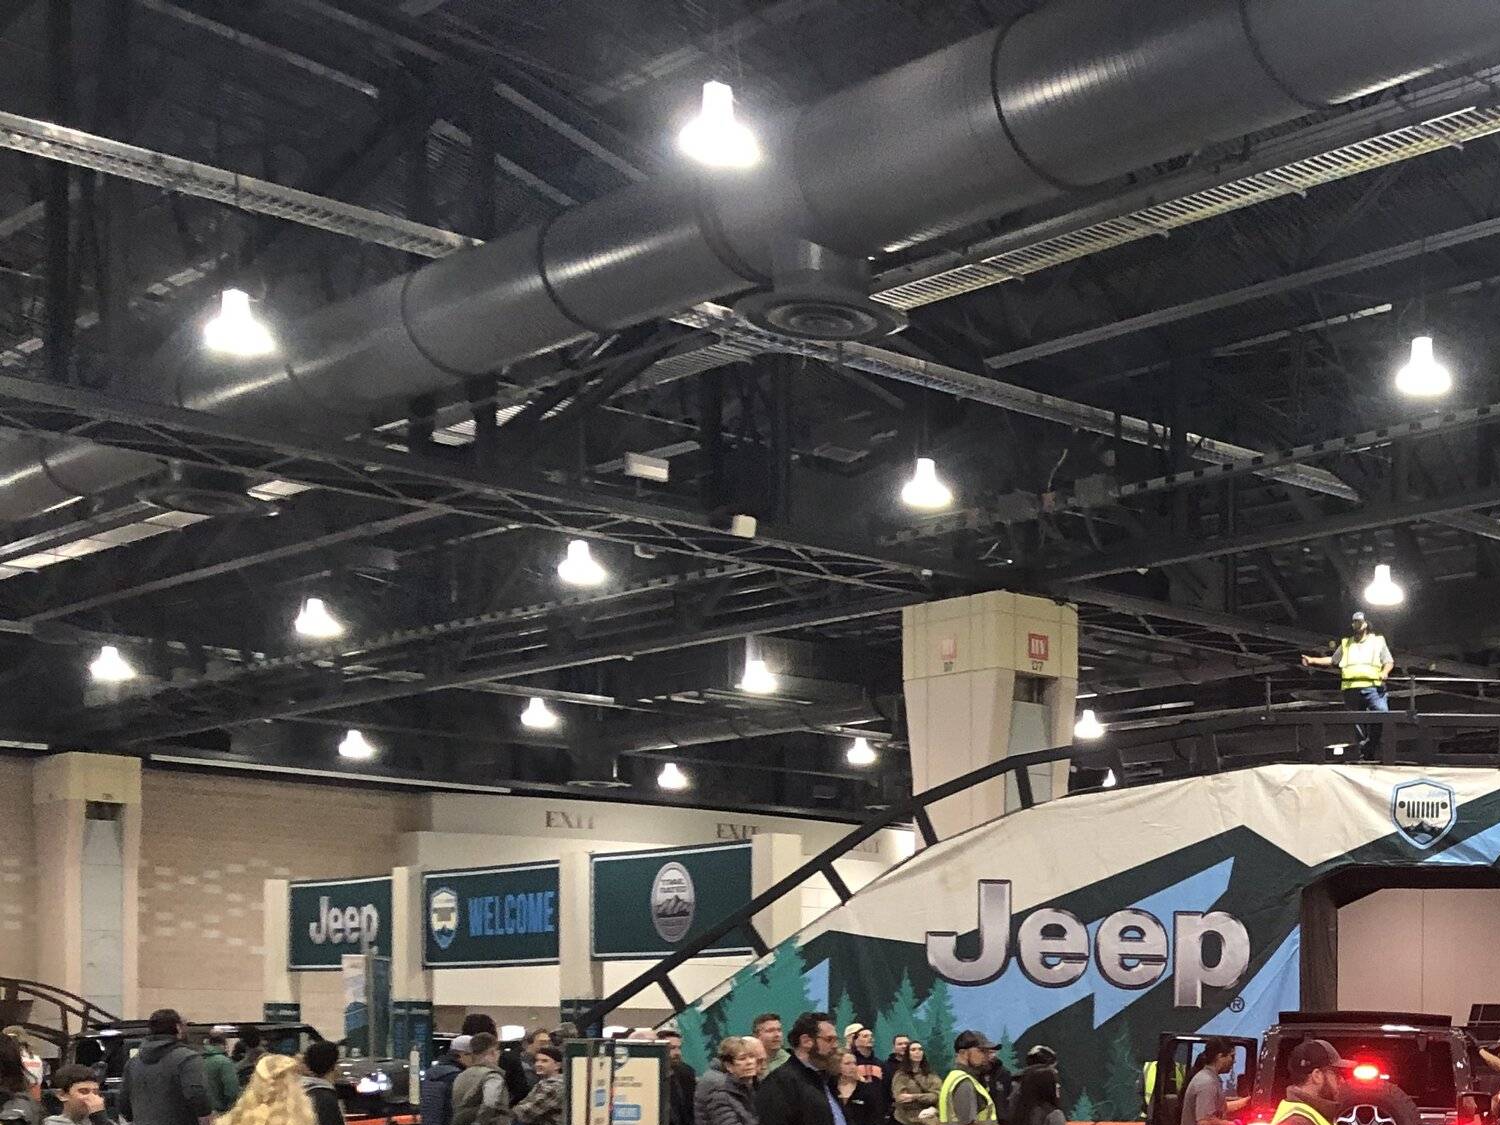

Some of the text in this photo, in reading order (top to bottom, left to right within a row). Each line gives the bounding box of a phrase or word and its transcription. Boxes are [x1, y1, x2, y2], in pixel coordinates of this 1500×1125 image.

[545, 810, 594, 830] EXIT
[716, 822, 760, 839] EXIT
[309, 895, 379, 955] Jeep
[468, 890, 556, 937] WELCOME
[925, 879, 1250, 1007] Jeep
